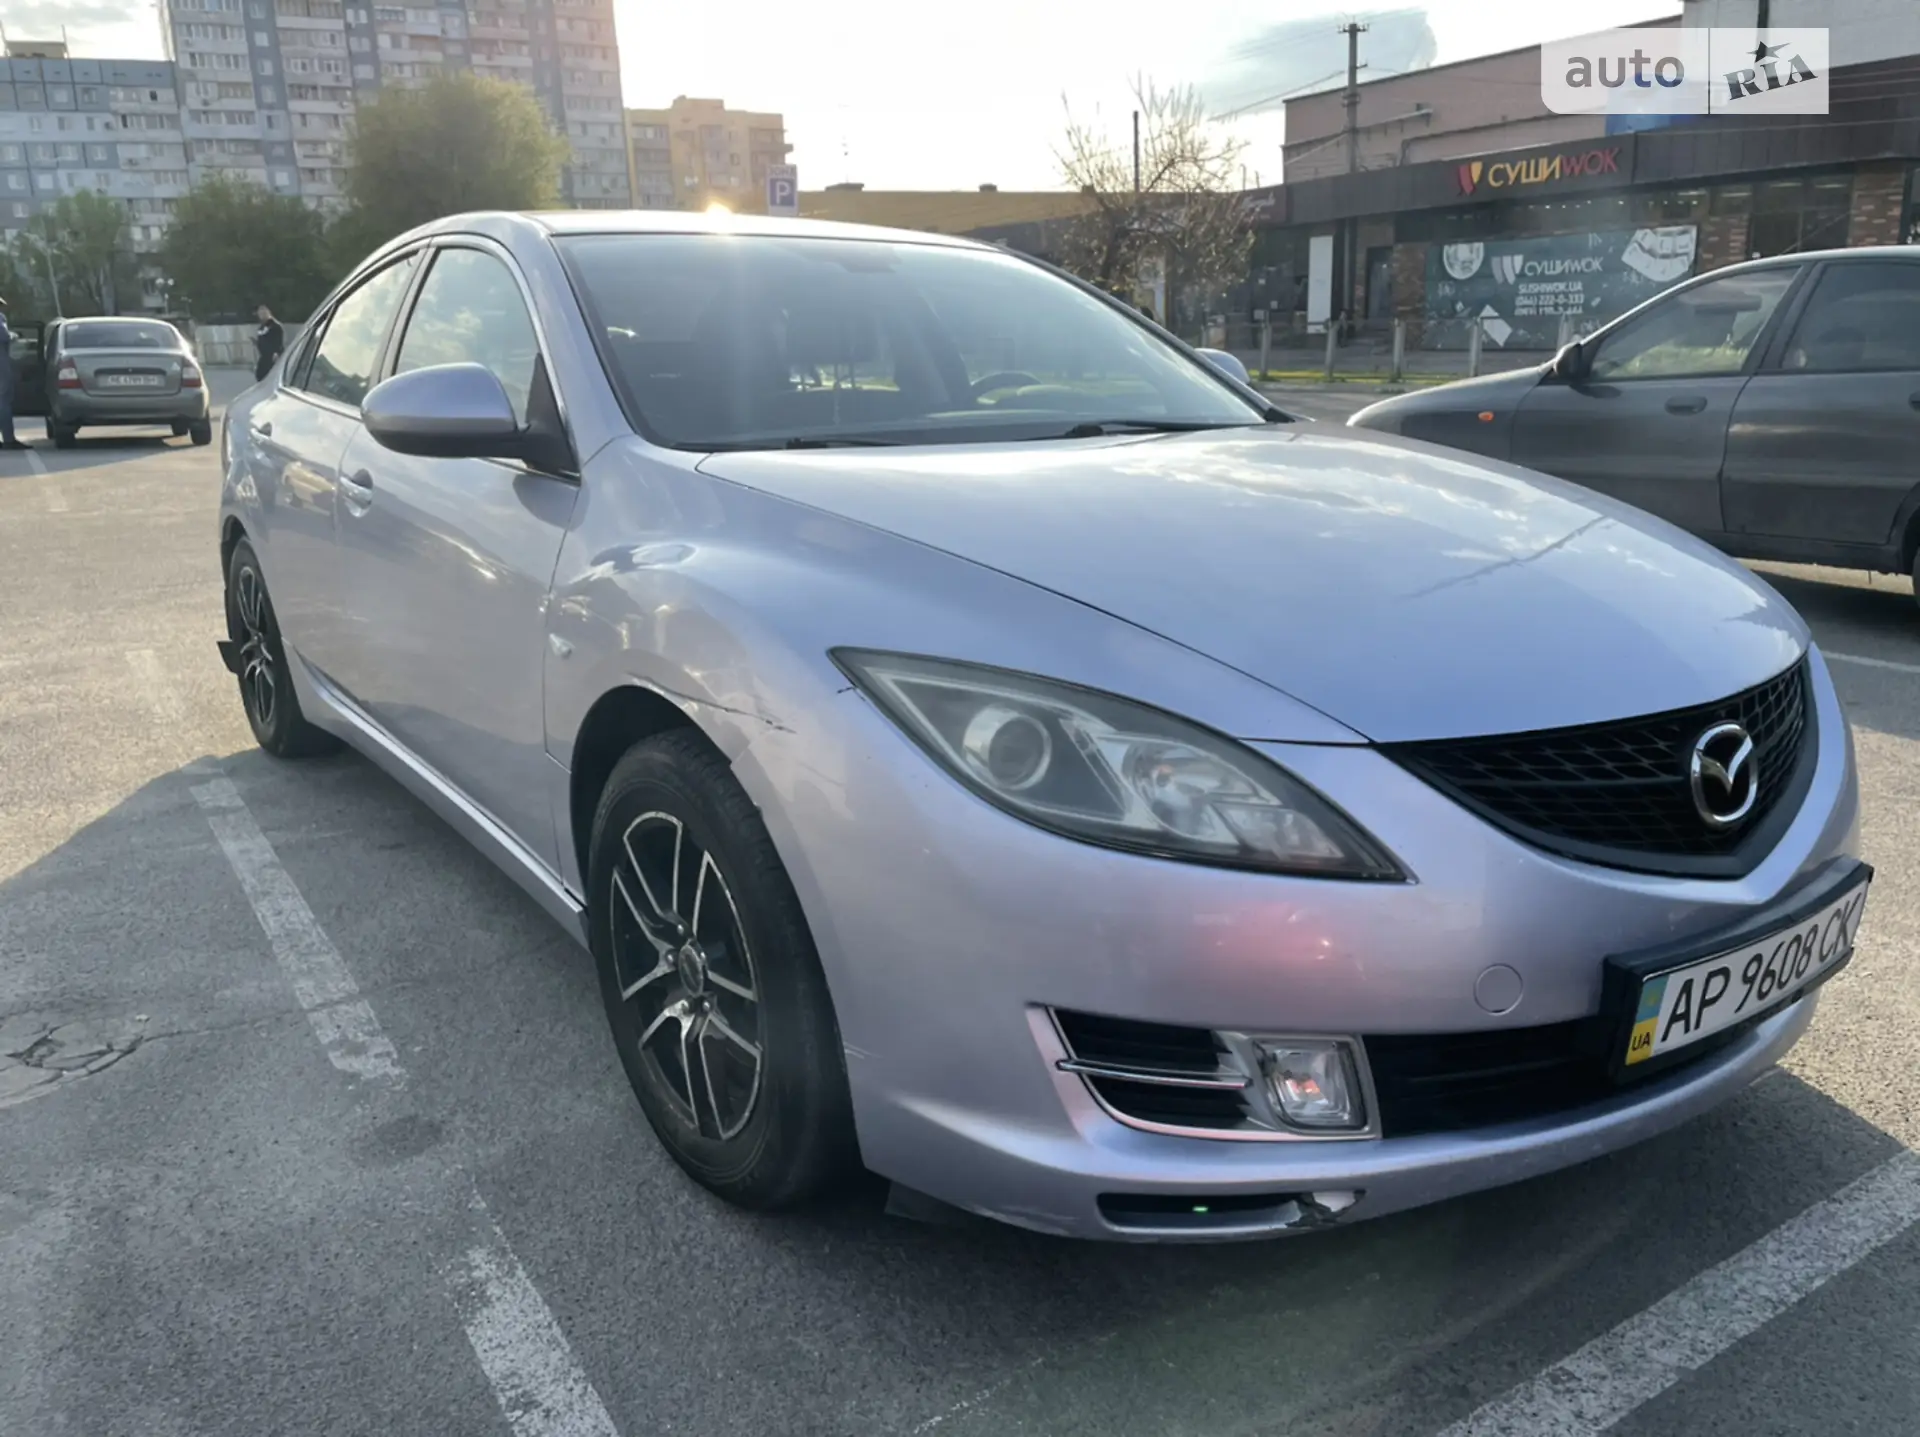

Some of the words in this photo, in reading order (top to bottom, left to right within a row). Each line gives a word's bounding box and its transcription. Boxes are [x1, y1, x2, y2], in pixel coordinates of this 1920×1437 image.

[1661, 966, 1731, 1042] AP
[1734, 923, 1819, 1014] 9608
[1819, 892, 1862, 963] CK
[1631, 1031, 1650, 1052] UA
